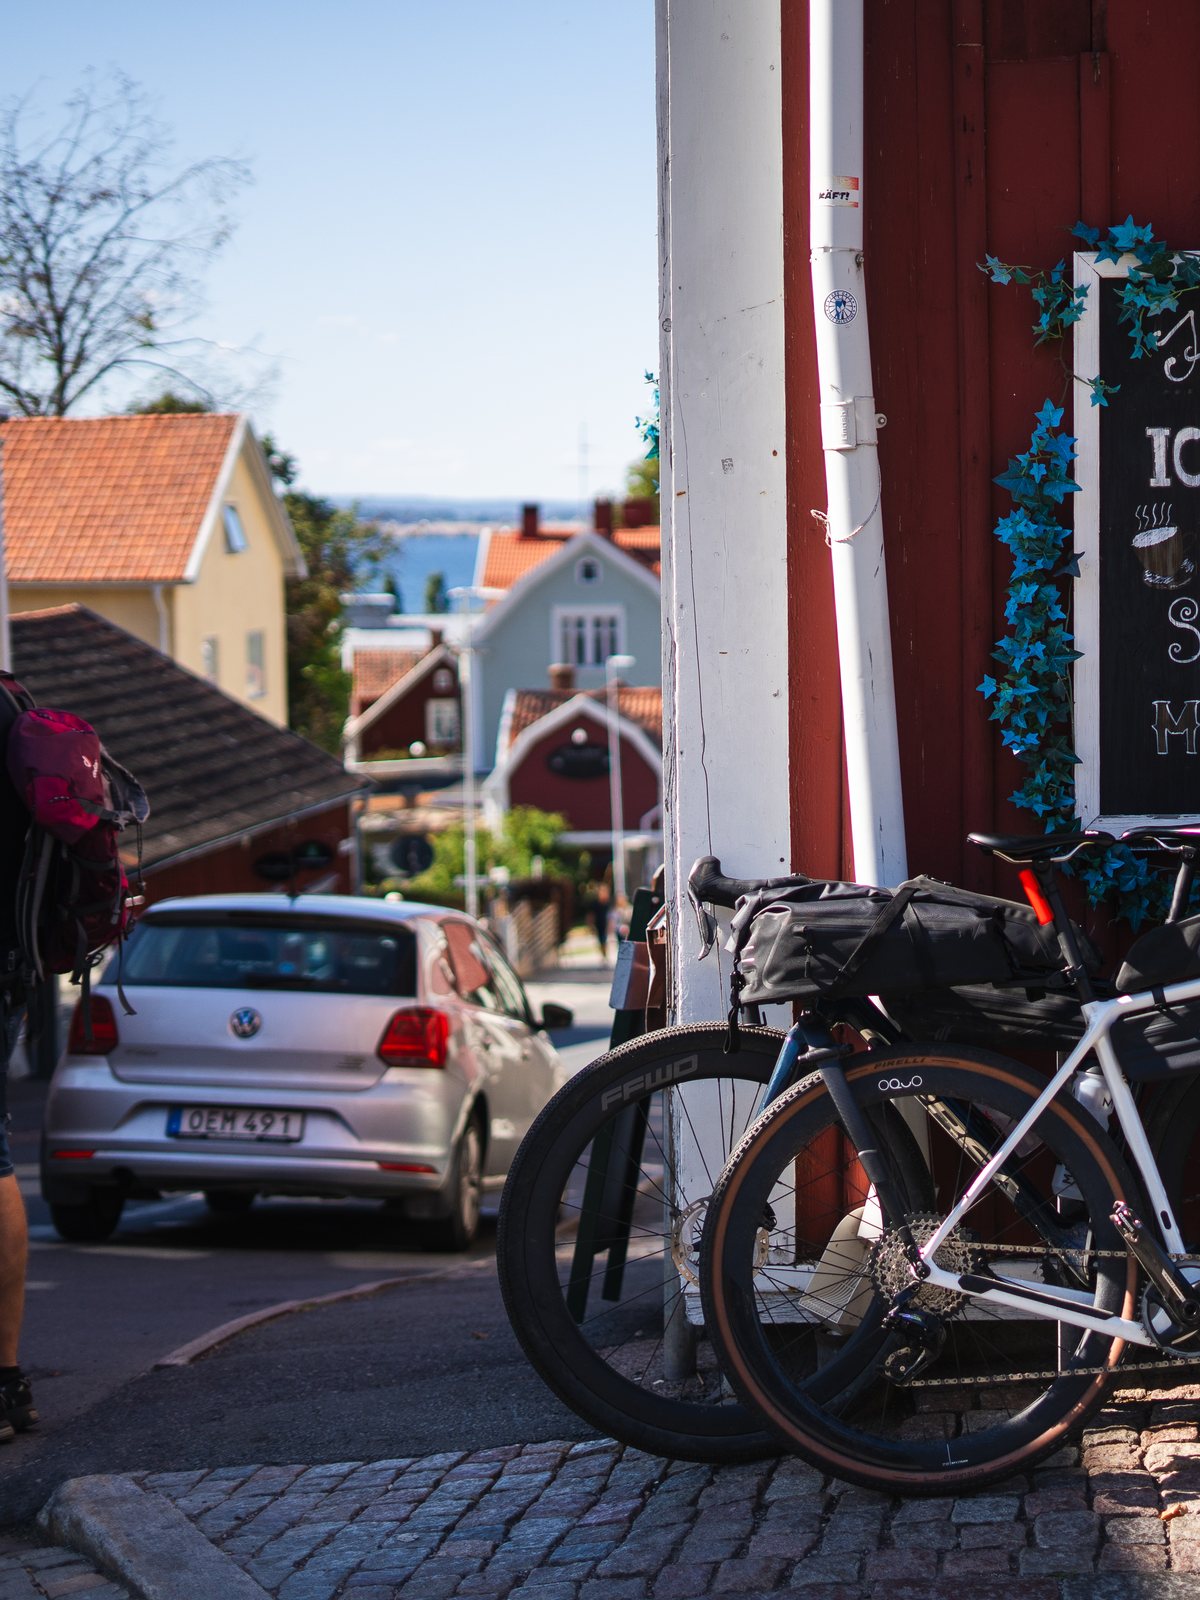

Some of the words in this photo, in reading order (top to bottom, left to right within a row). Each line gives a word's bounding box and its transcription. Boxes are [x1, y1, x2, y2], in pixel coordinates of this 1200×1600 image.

[873, 1056, 927, 1070] PIRELLI
[600, 1053, 699, 1112] FFWD
[189, 1110, 236, 1131] OEM
[243, 1112, 291, 1134] 491
